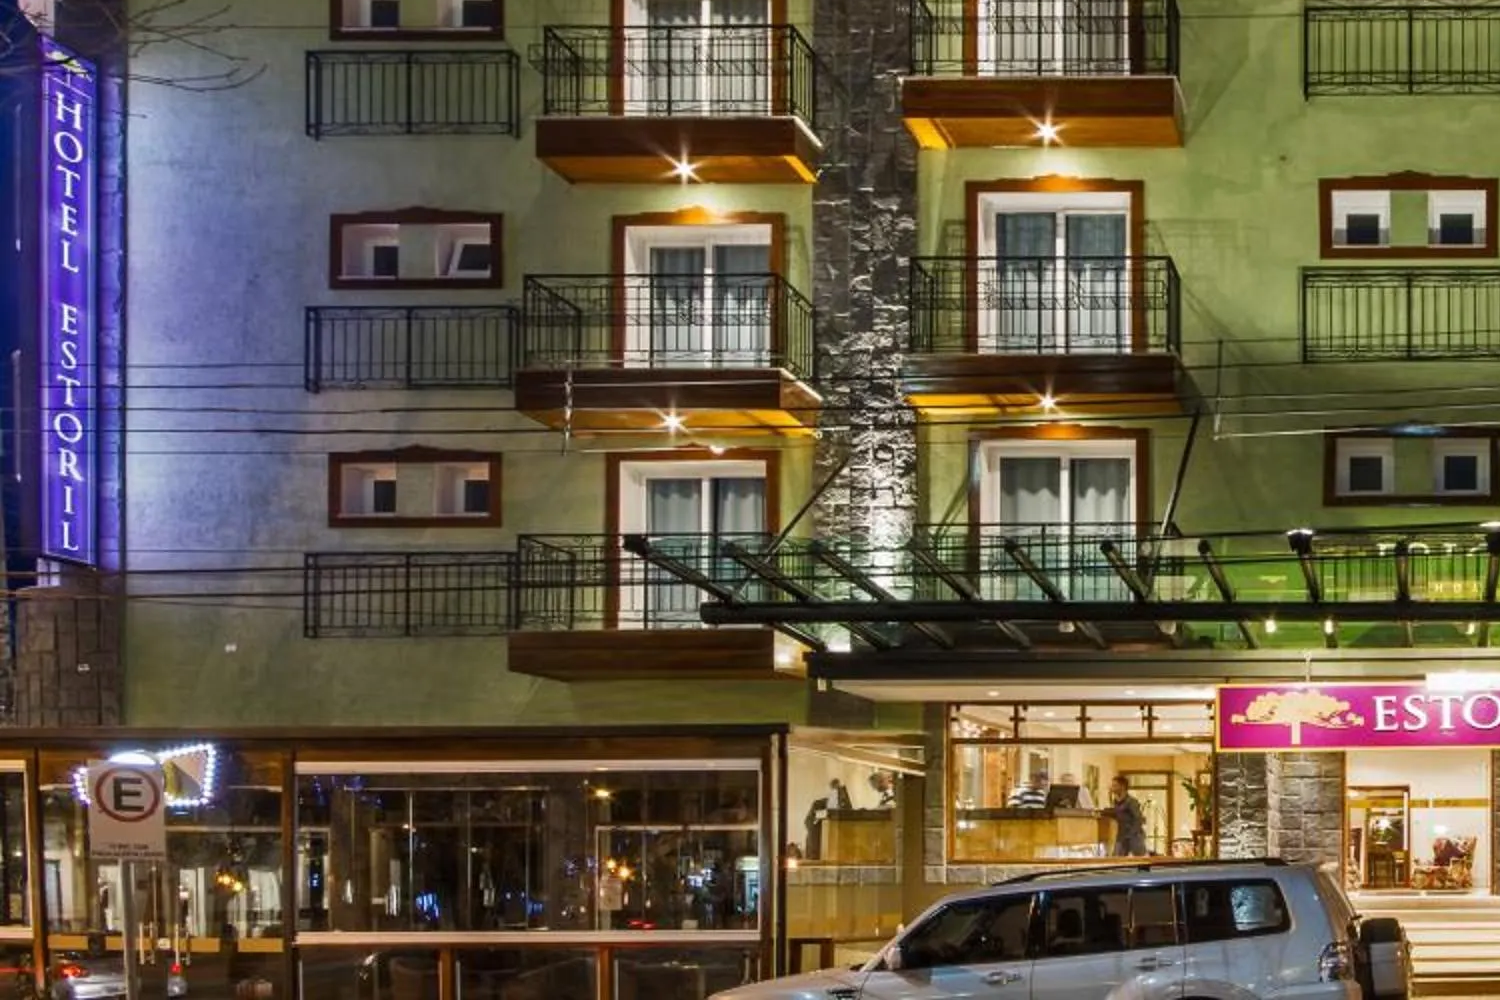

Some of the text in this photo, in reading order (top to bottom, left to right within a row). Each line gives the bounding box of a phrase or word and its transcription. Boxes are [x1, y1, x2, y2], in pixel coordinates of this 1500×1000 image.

[54, 91, 84, 551] HOTEL ESTORIL
[113, 777, 144, 812] E
